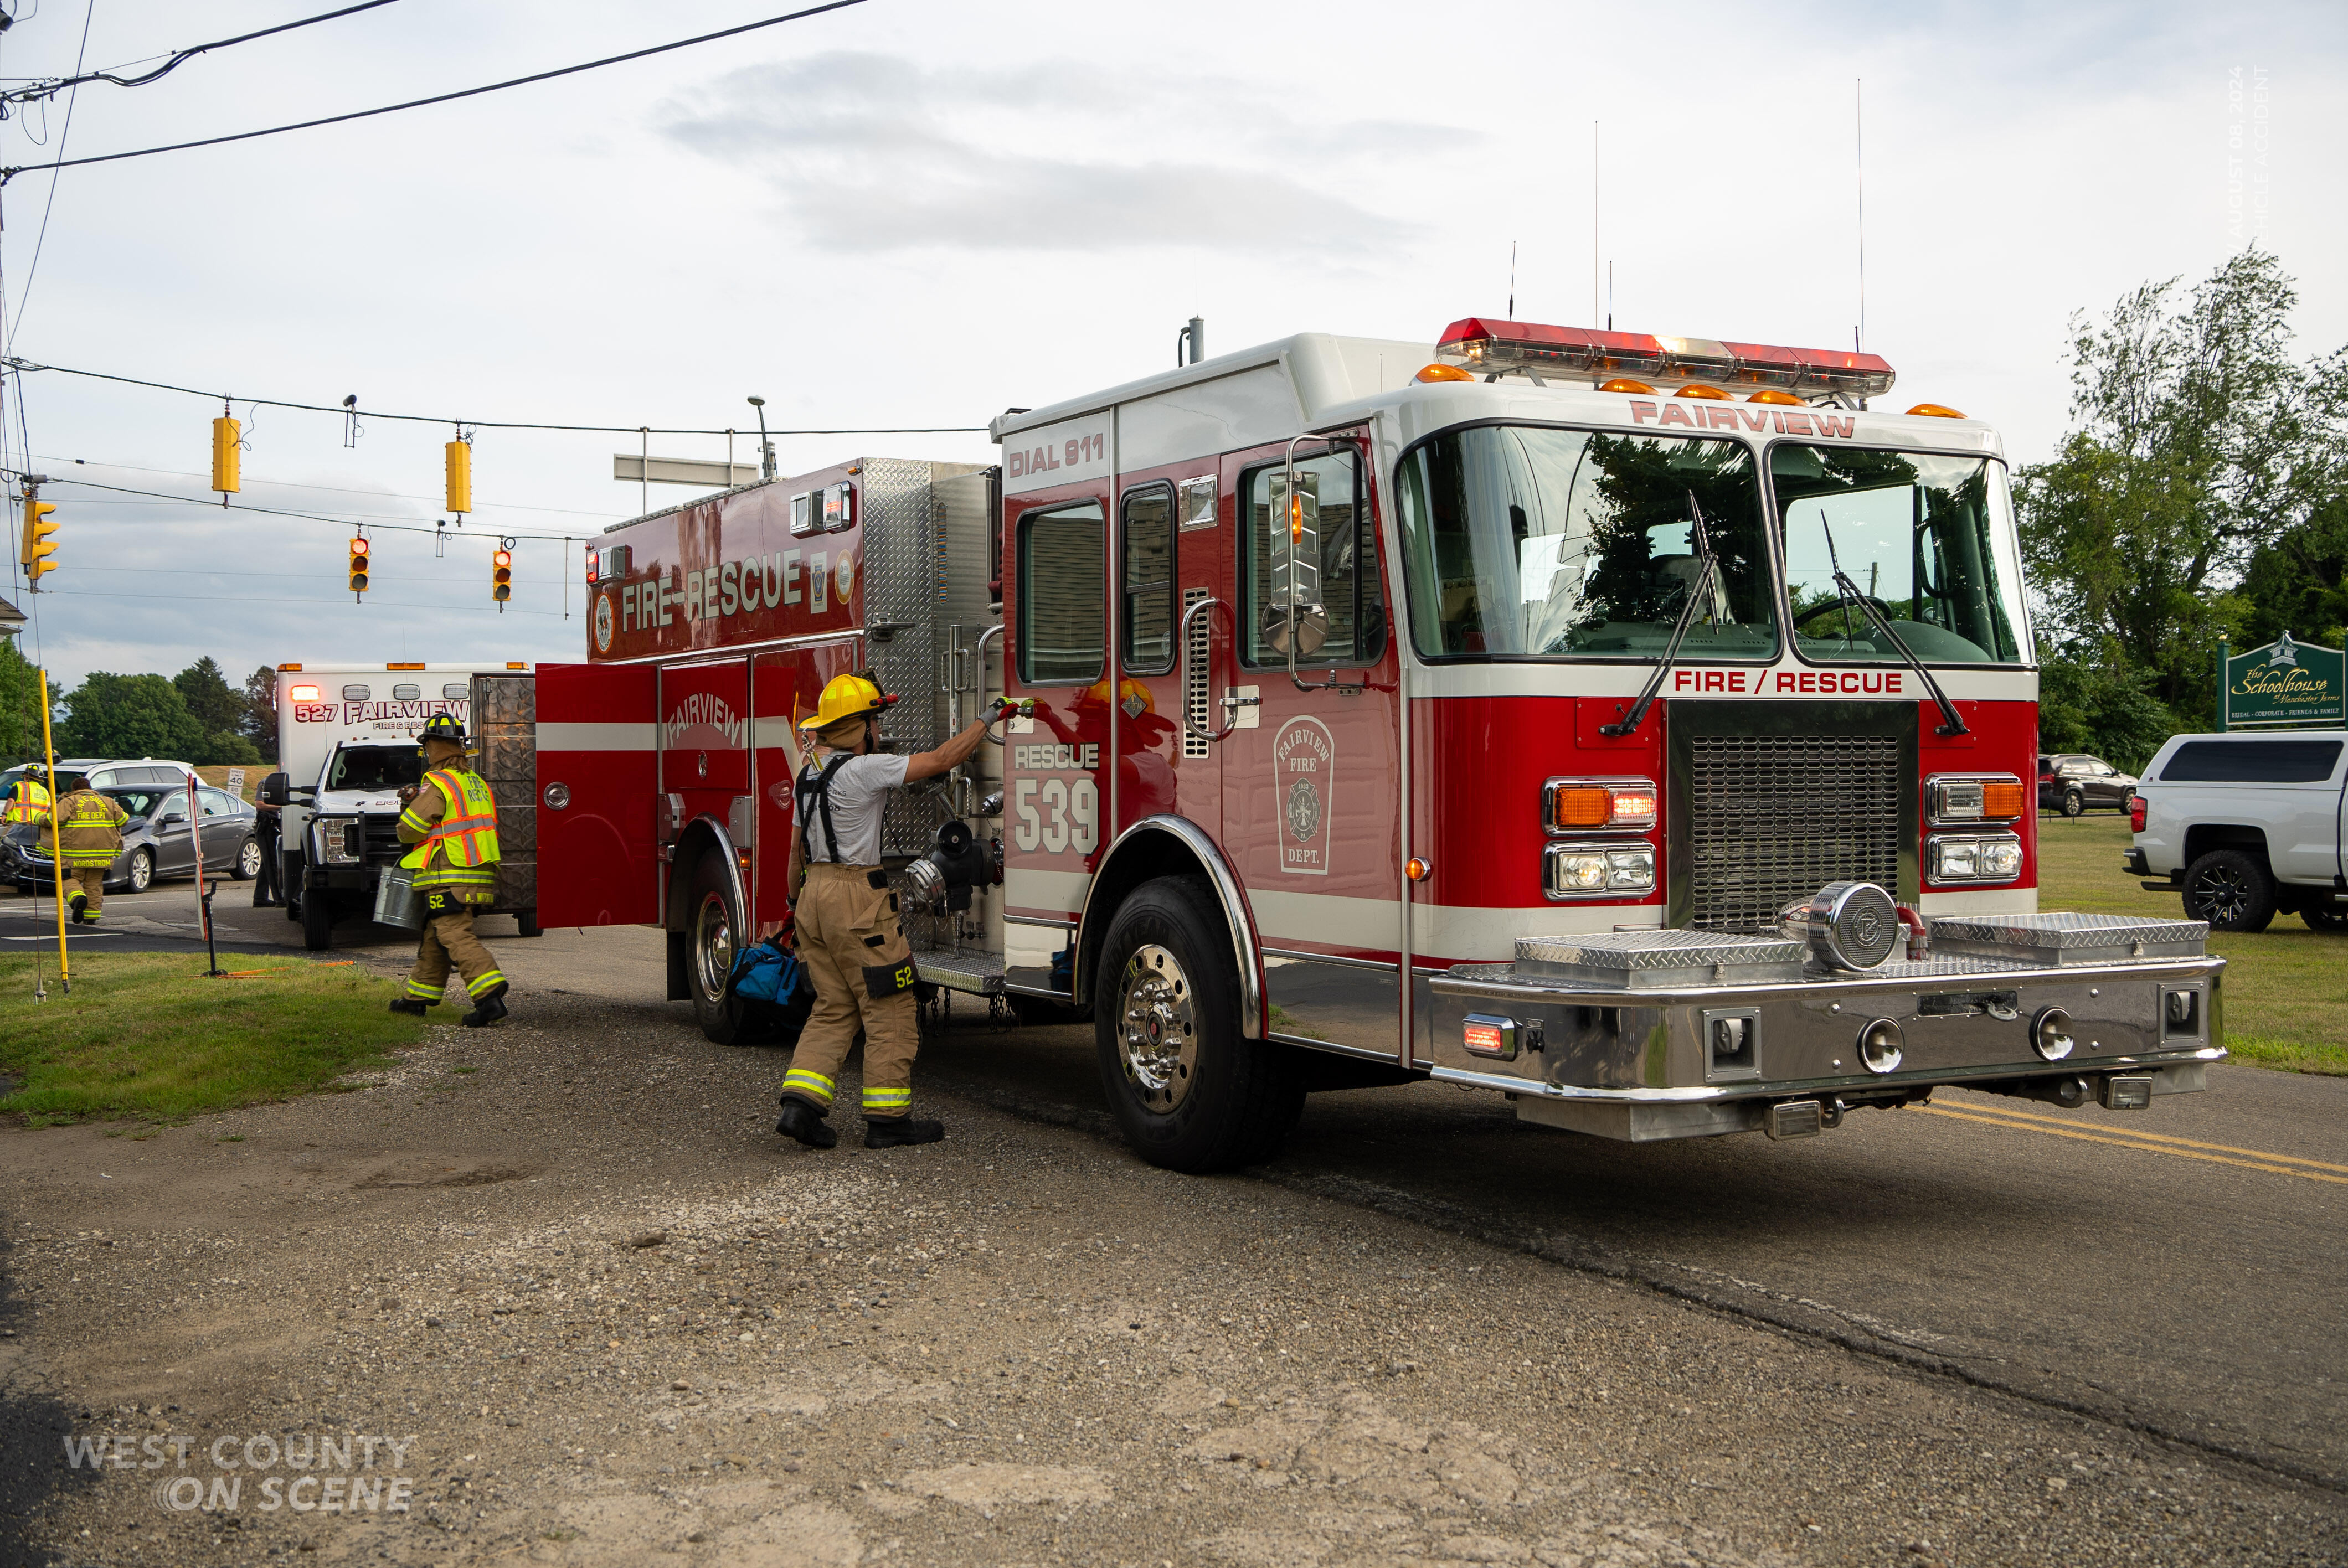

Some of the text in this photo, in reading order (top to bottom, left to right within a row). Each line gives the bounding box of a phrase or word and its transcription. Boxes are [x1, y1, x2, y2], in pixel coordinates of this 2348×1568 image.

[1629, 400, 1855, 439] FAIRVIEW
[1010, 432, 1103, 478] DIAL 911
[622, 546, 802, 633] FIRE-RESCUE
[1675, 670, 1745, 692] FIRE
[1776, 672, 1902, 693] RESCUE
[2231, 668, 2328, 694] Schoolhouse
[2246, 664, 2267, 679] The
[2272, 692, 2317, 704] Manchester
[2312, 692, 2340, 704] Farms
[295, 700, 470, 725] 527 FAIRVIEW
[667, 692, 740, 749] FAIRVIEW
[373, 721, 395, 730] FIRE
[1015, 742, 1099, 770] RESCUE
[1278, 728, 1330, 762] FAIRVIEW
[1290, 757, 1316, 772] FIRE
[76, 795, 109, 813] LAKE SHORE
[1015, 777, 1099, 855] 539
[73, 859, 111, 868] NORDSTROM
[1288, 848, 1319, 864] DEPT.
[429, 895, 445, 909] 52
[895, 966, 914, 988] 52
